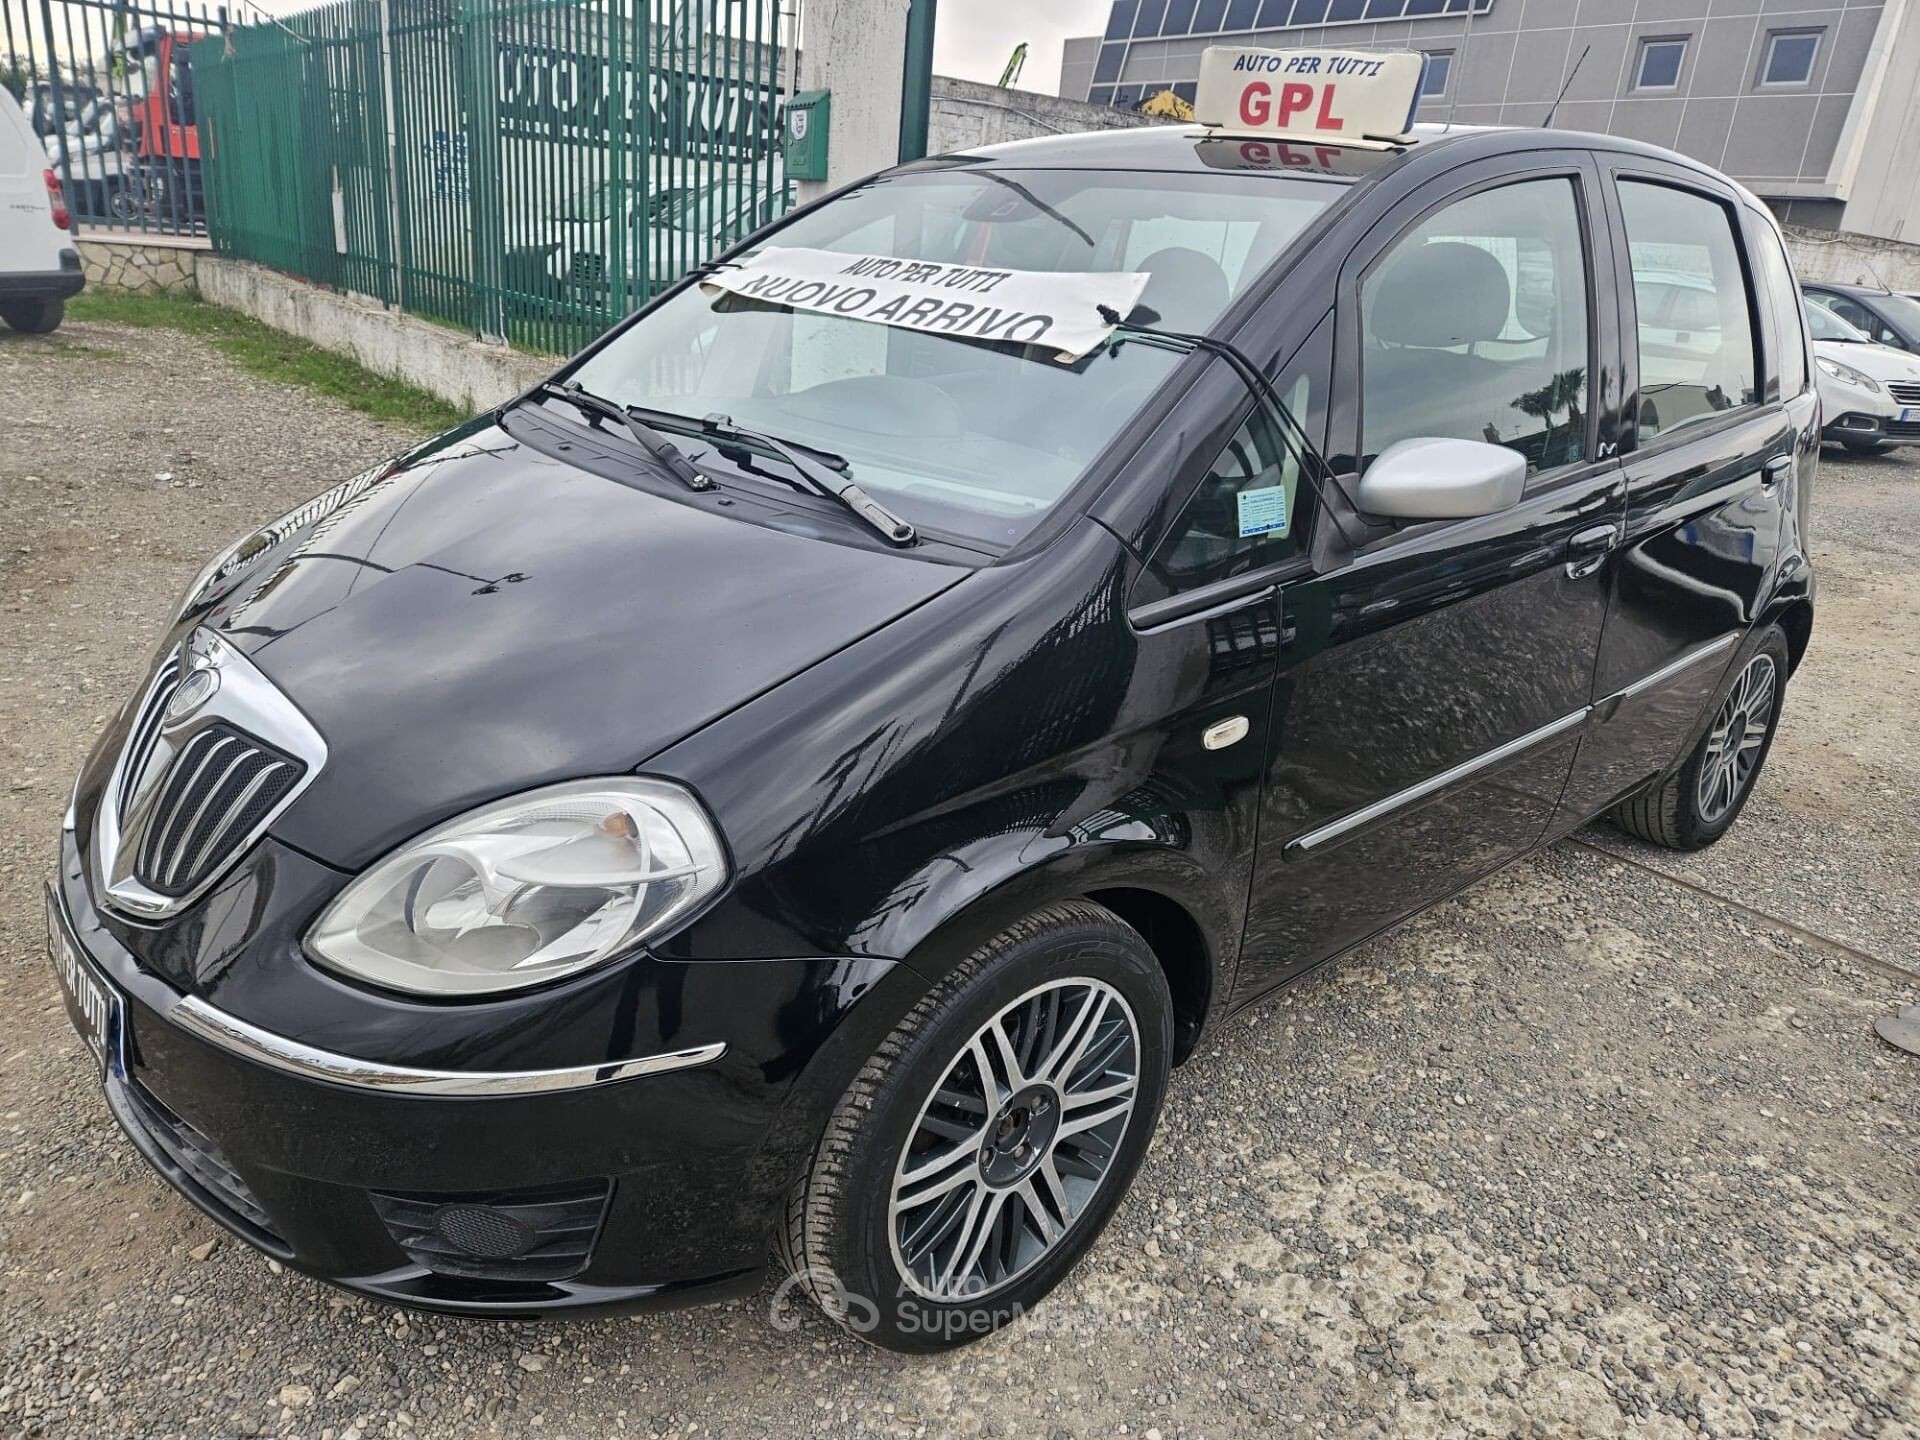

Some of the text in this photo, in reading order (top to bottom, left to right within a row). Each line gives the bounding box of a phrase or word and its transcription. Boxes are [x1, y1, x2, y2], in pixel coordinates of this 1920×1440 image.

[1233, 54, 1385, 77] AUTO PER TUTTI
[1239, 81, 1344, 130] GPL
[839, 256, 1014, 293] AUTO PER TUTTI
[738, 274, 1054, 343] NUOVO ARRIVO
[77, 963, 106, 1047] TUTTI
